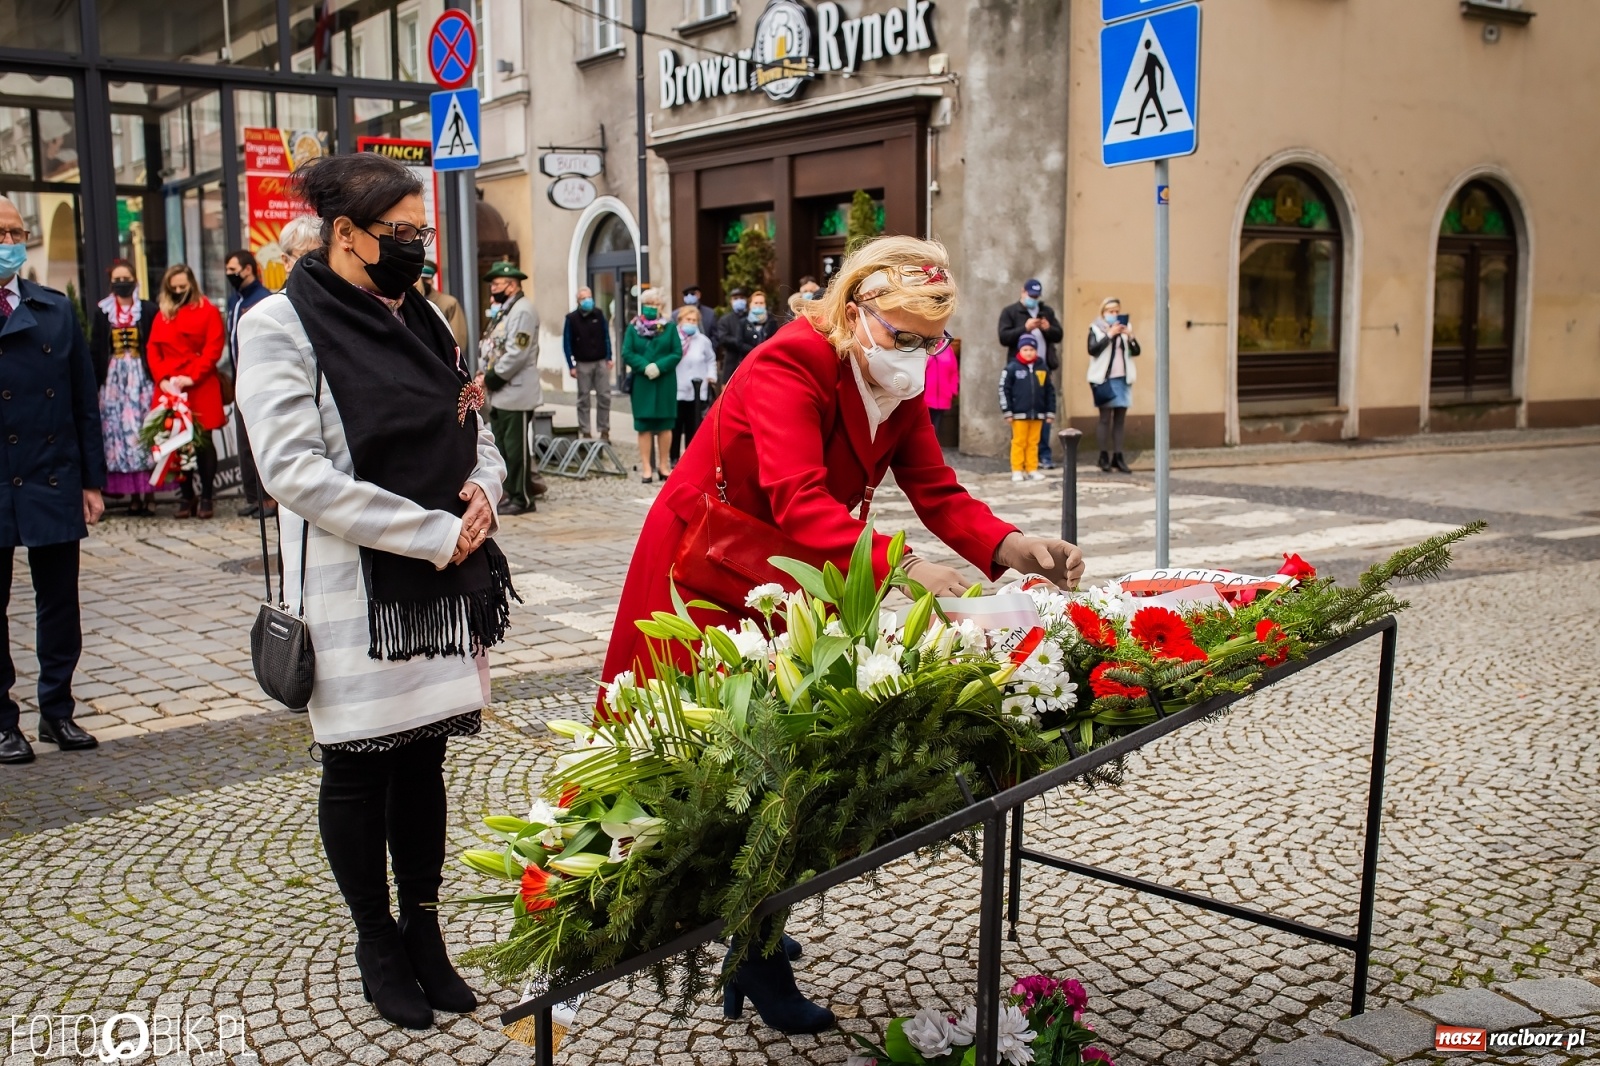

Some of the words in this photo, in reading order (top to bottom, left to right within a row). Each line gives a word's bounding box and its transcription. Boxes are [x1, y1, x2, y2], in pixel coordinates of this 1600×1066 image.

[659, 46, 753, 110] Browar
[817, 0, 932, 78] Rynek
[268, 200, 289, 210] DWA
[253, 209, 264, 219] W
[264, 210, 288, 220] CENIE
